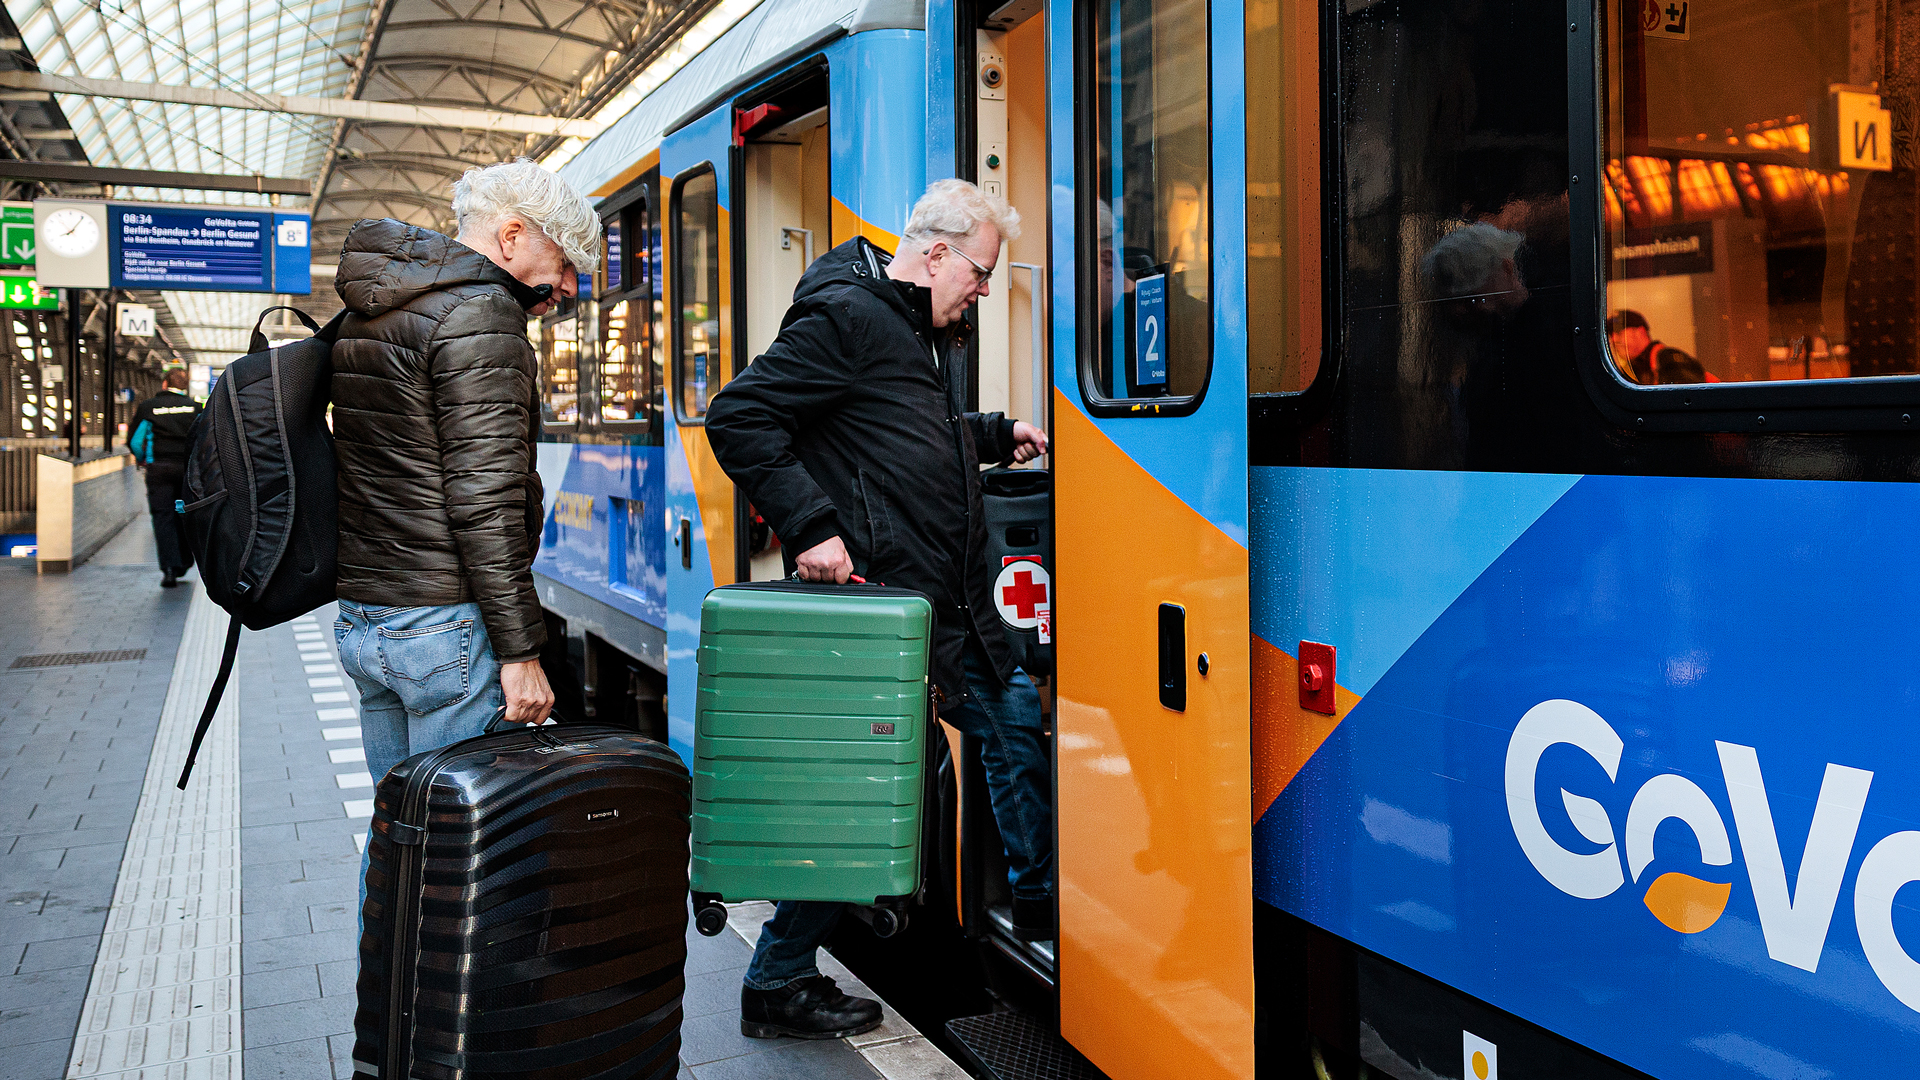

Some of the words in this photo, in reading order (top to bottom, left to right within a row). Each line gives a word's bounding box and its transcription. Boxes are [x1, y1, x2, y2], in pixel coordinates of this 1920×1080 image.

[123, 213, 153, 225] 08:34
[123, 225, 190, 237] Berlin-Spandau
[200, 228, 227, 239] Berlin
[227, 229, 260, 240] Gesund
[123, 235, 134, 243] via
[135, 236, 148, 244] Bad
[128, 319, 147, 332] M
[1145, 315, 1158, 361] 2
